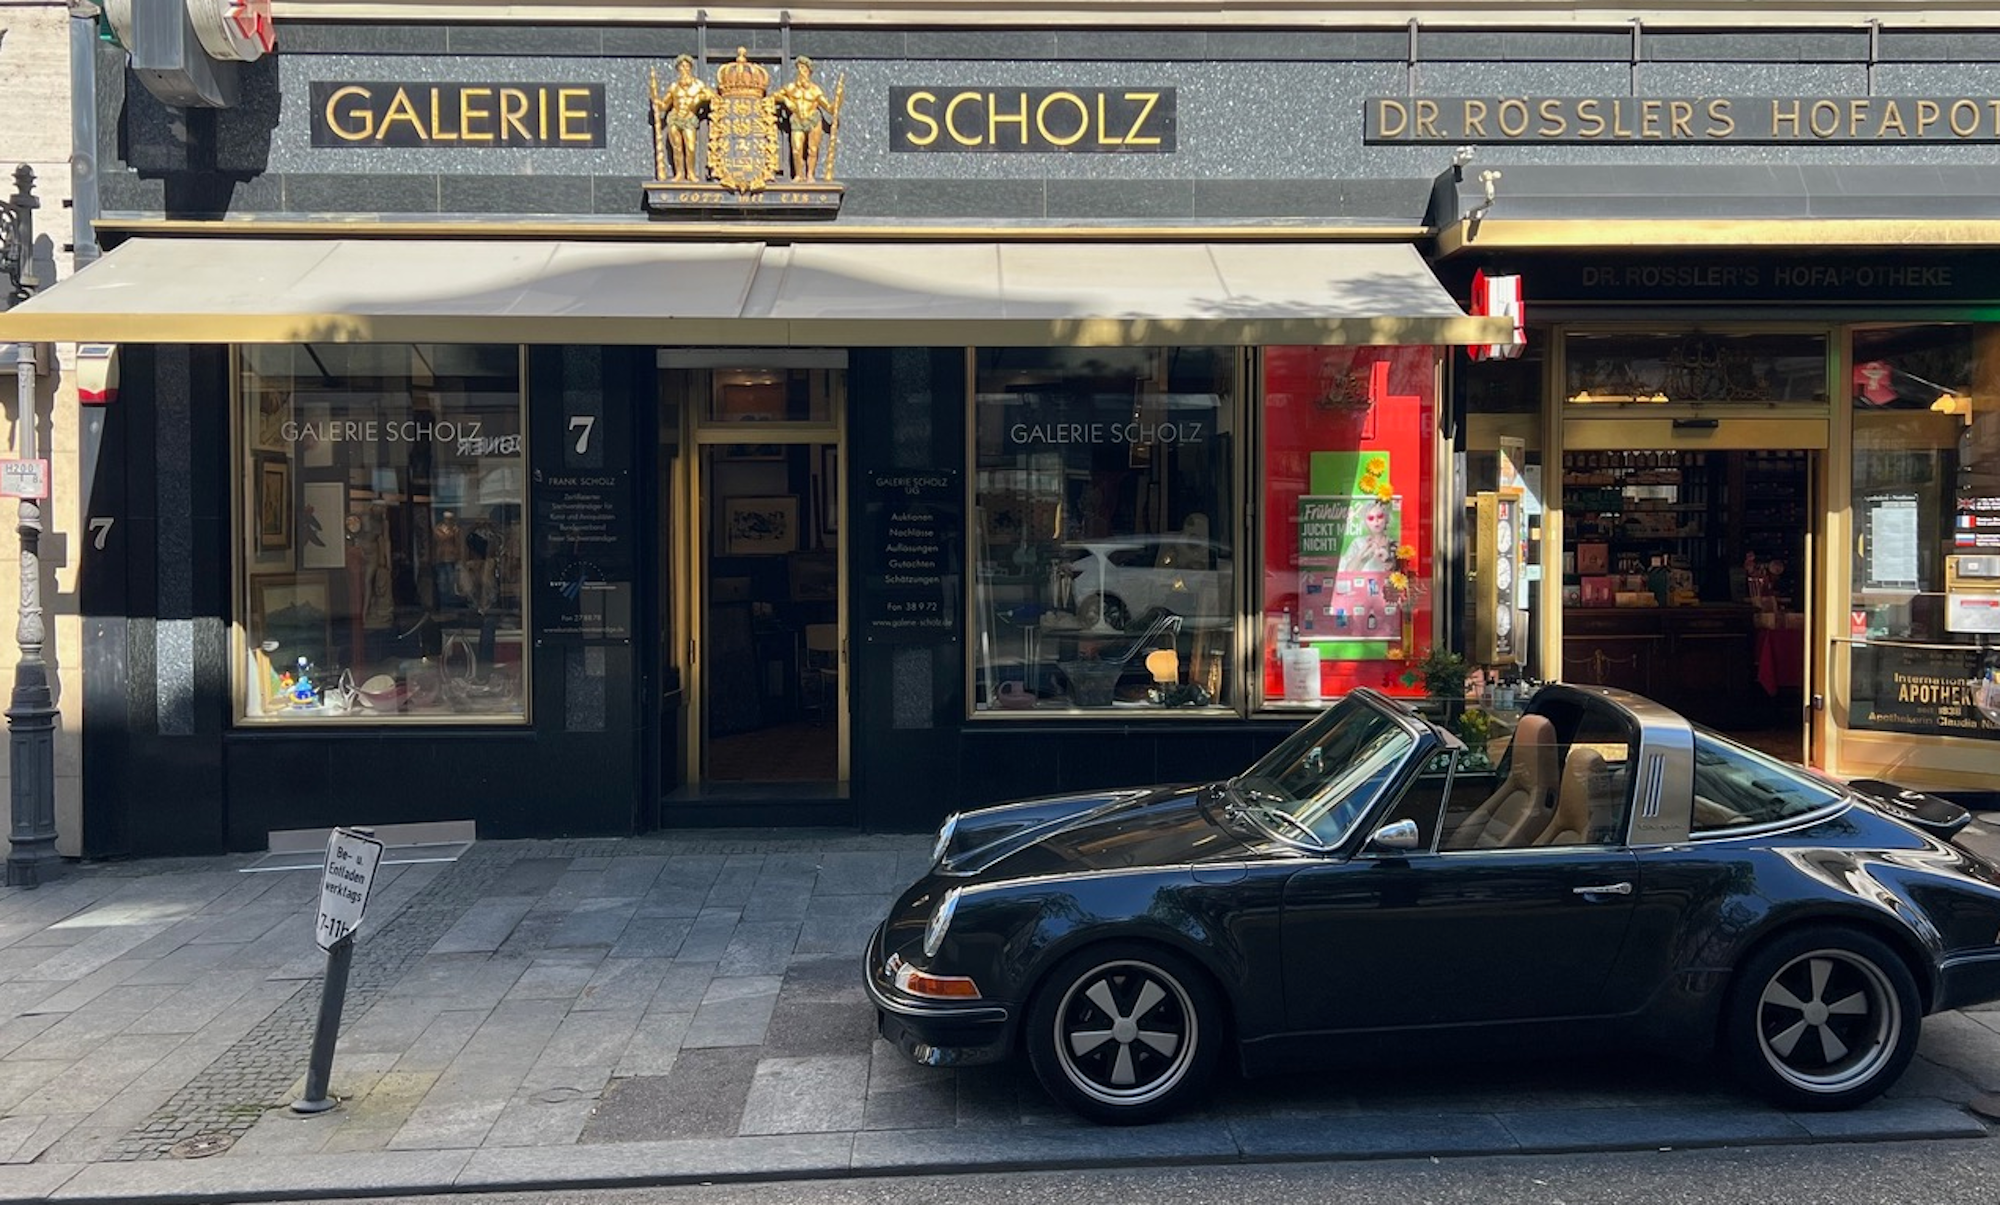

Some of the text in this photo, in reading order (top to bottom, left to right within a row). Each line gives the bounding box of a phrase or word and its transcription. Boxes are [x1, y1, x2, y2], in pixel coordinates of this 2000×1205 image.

[325, 85, 592, 140] GALERIE
[906, 91, 1161, 146] SCHOLZ
[1379, 99, 1448, 138] DR.
[1464, 95, 1736, 138] RÖSSLER'S
[1582, 267, 1621, 286] DR.
[1774, 267, 1952, 286] HOFAPOTHEKE
[281, 421, 483, 442] GALERIE SCHOLZ
[568, 415, 596, 454] 7
[1010, 423, 1202, 443] GALERIE SCHOLZ
[6, 463, 34, 473] H200
[548, 477, 615, 486] FRANK SCHOLZ
[875, 477, 948, 487] GALERIE SCHOLZ
[890, 512, 934, 521] Auktionen
[89, 517, 114, 550] 7
[1301, 523, 1334, 536] JUCKT
[1303, 538, 1336, 551] NICHT!
[888, 559, 936, 569] Gutachten
[886, 602, 903, 611] Fon
[1893, 672, 1966, 687] Internation
[1898, 683, 1976, 706] APOTHEK
[1868, 711, 1933, 725] Apothekerin
[1936, 716, 1978, 728] Claudia
[336, 846, 353, 860] Be-
[328, 861, 366, 885] Entladen
[325, 881, 363, 904] werktags
